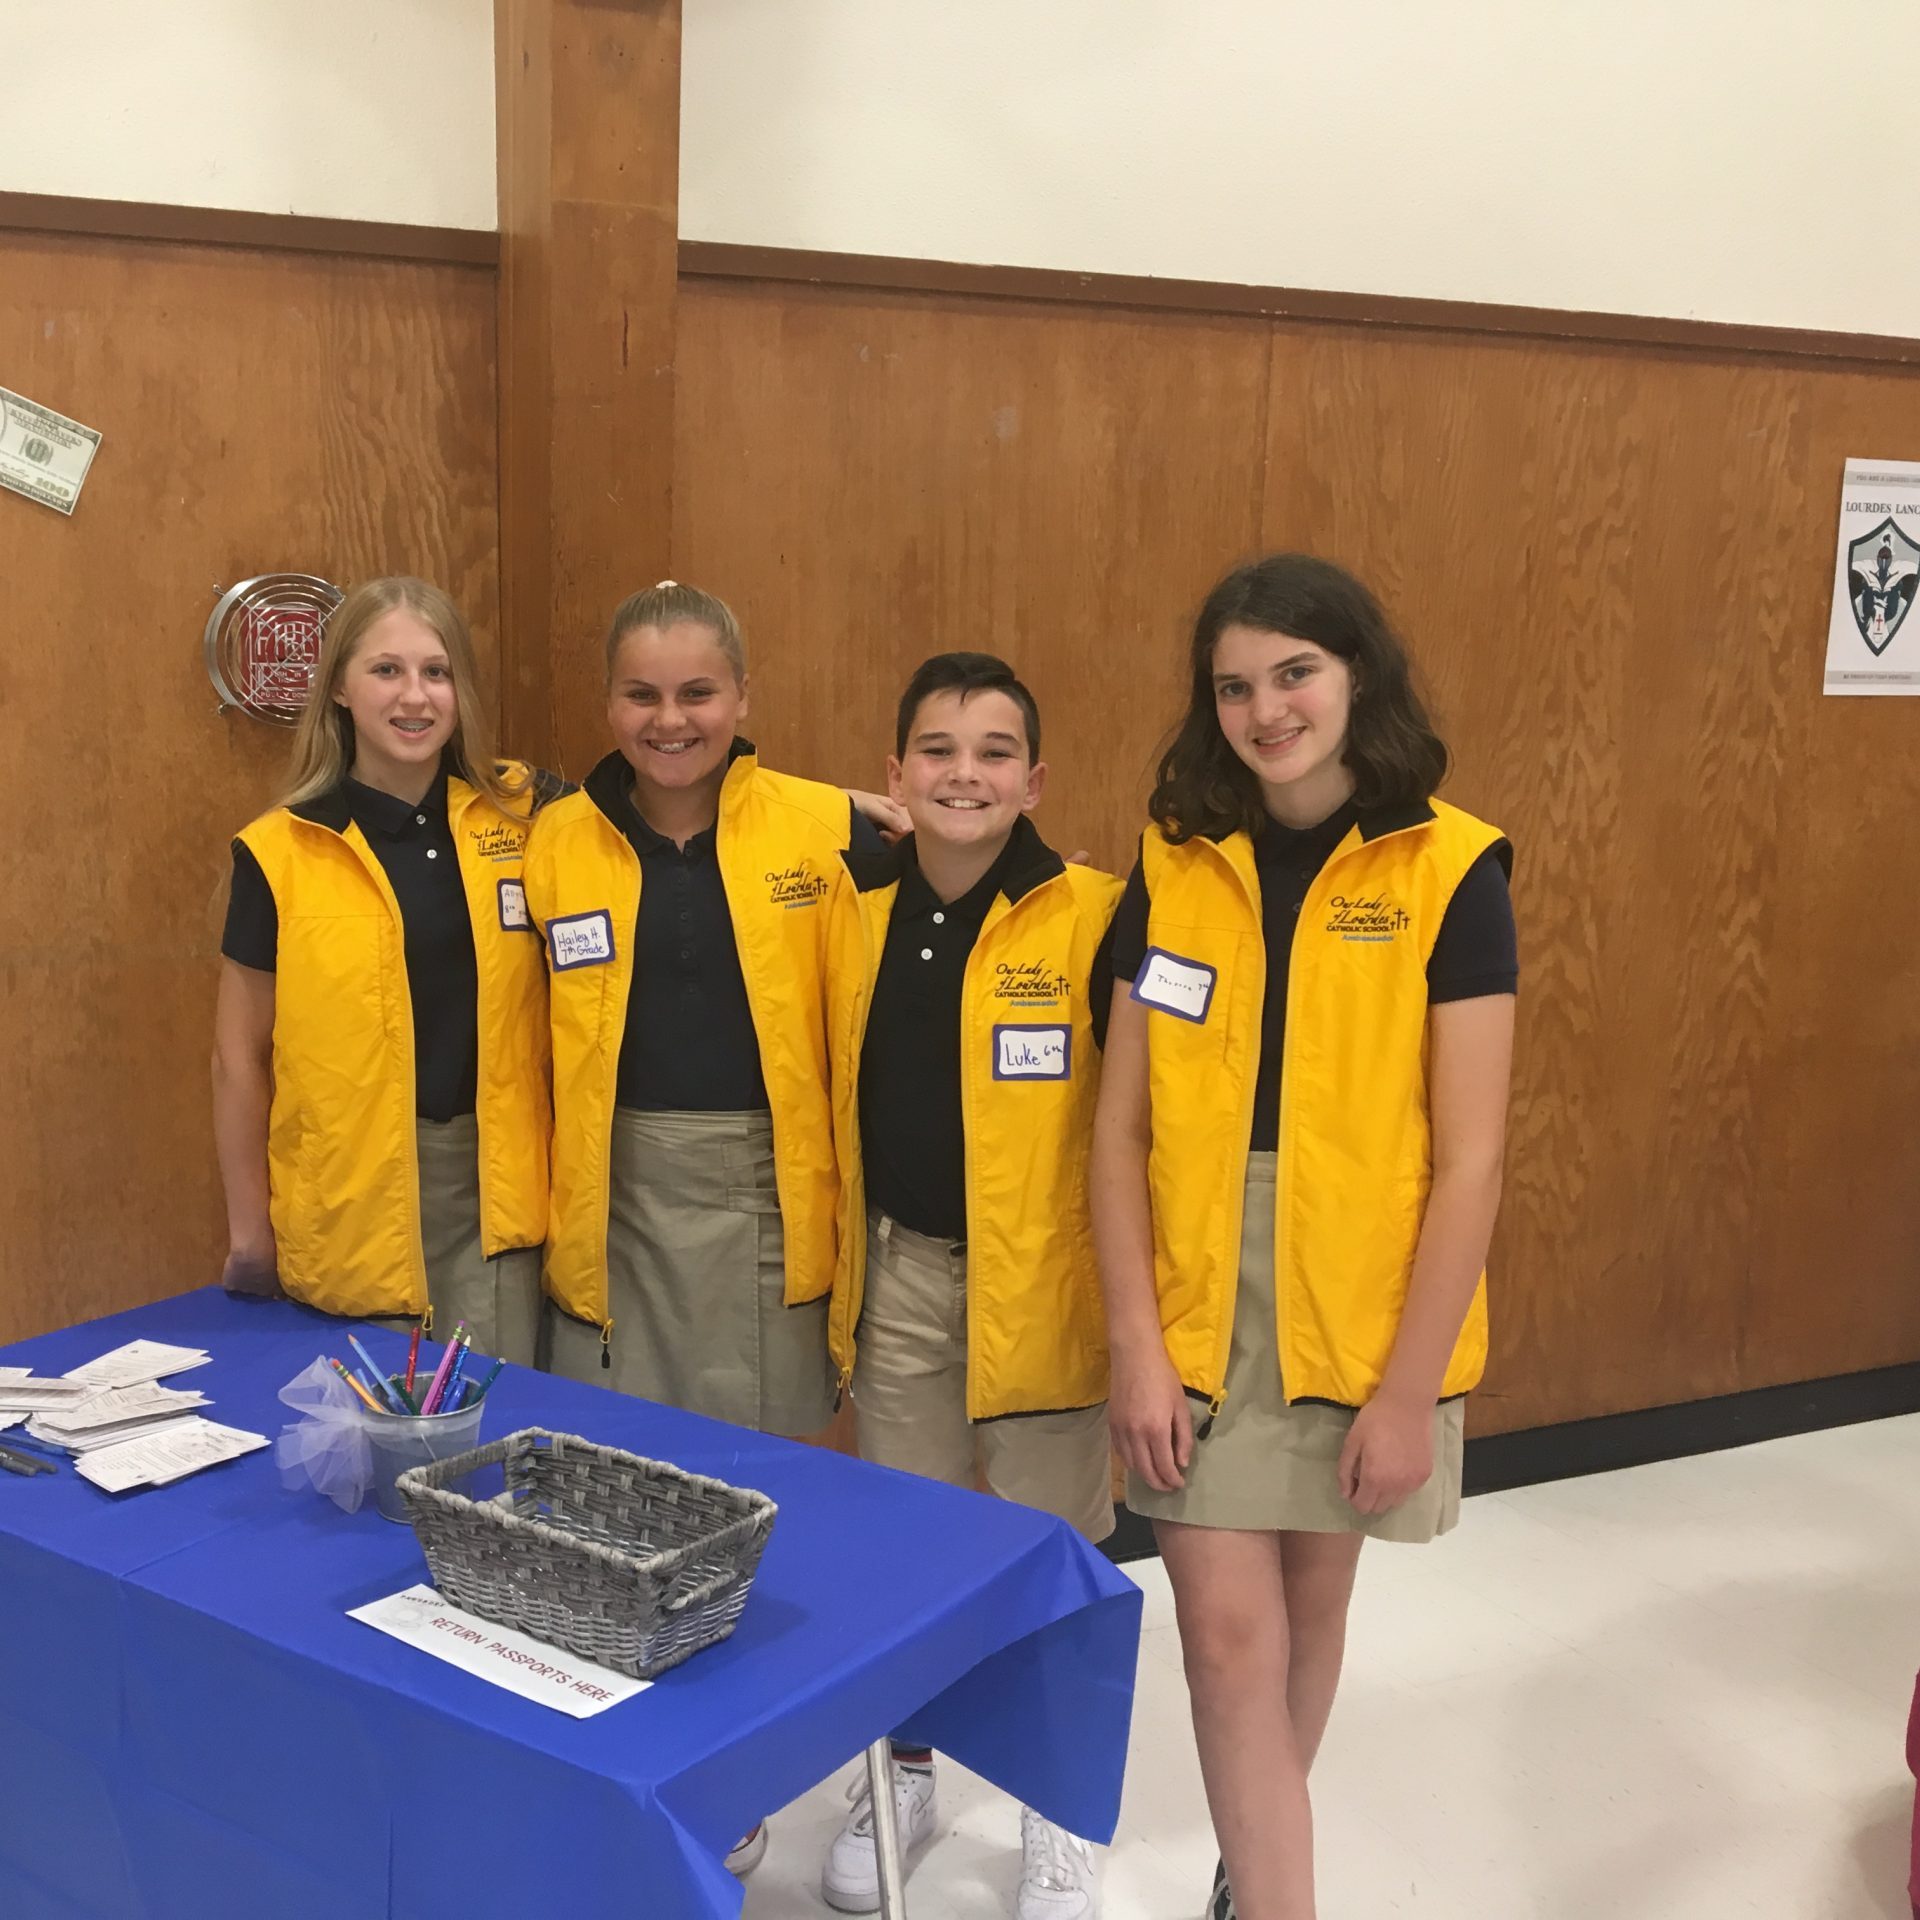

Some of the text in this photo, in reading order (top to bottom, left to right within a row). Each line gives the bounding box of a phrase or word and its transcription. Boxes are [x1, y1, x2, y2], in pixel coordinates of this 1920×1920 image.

[1846, 502, 1891, 513] LOURDES
[469, 821, 503, 841] Our Lady
[765, 862, 805, 885] Our Lady
[776, 872, 813, 895] Lourdes
[1330, 892, 1386, 917] Our Lady
[1338, 903, 1391, 925] Lourdes
[557, 928, 590, 948] Hailey
[577, 942, 605, 956] Grade
[996, 958, 1046, 983] Our Lady
[1003, 970, 1053, 990] Lourdes
[1005, 1043, 1063, 1066] Luke 6th
[428, 1616, 615, 1702] RETURN PASSPORTS HERE
